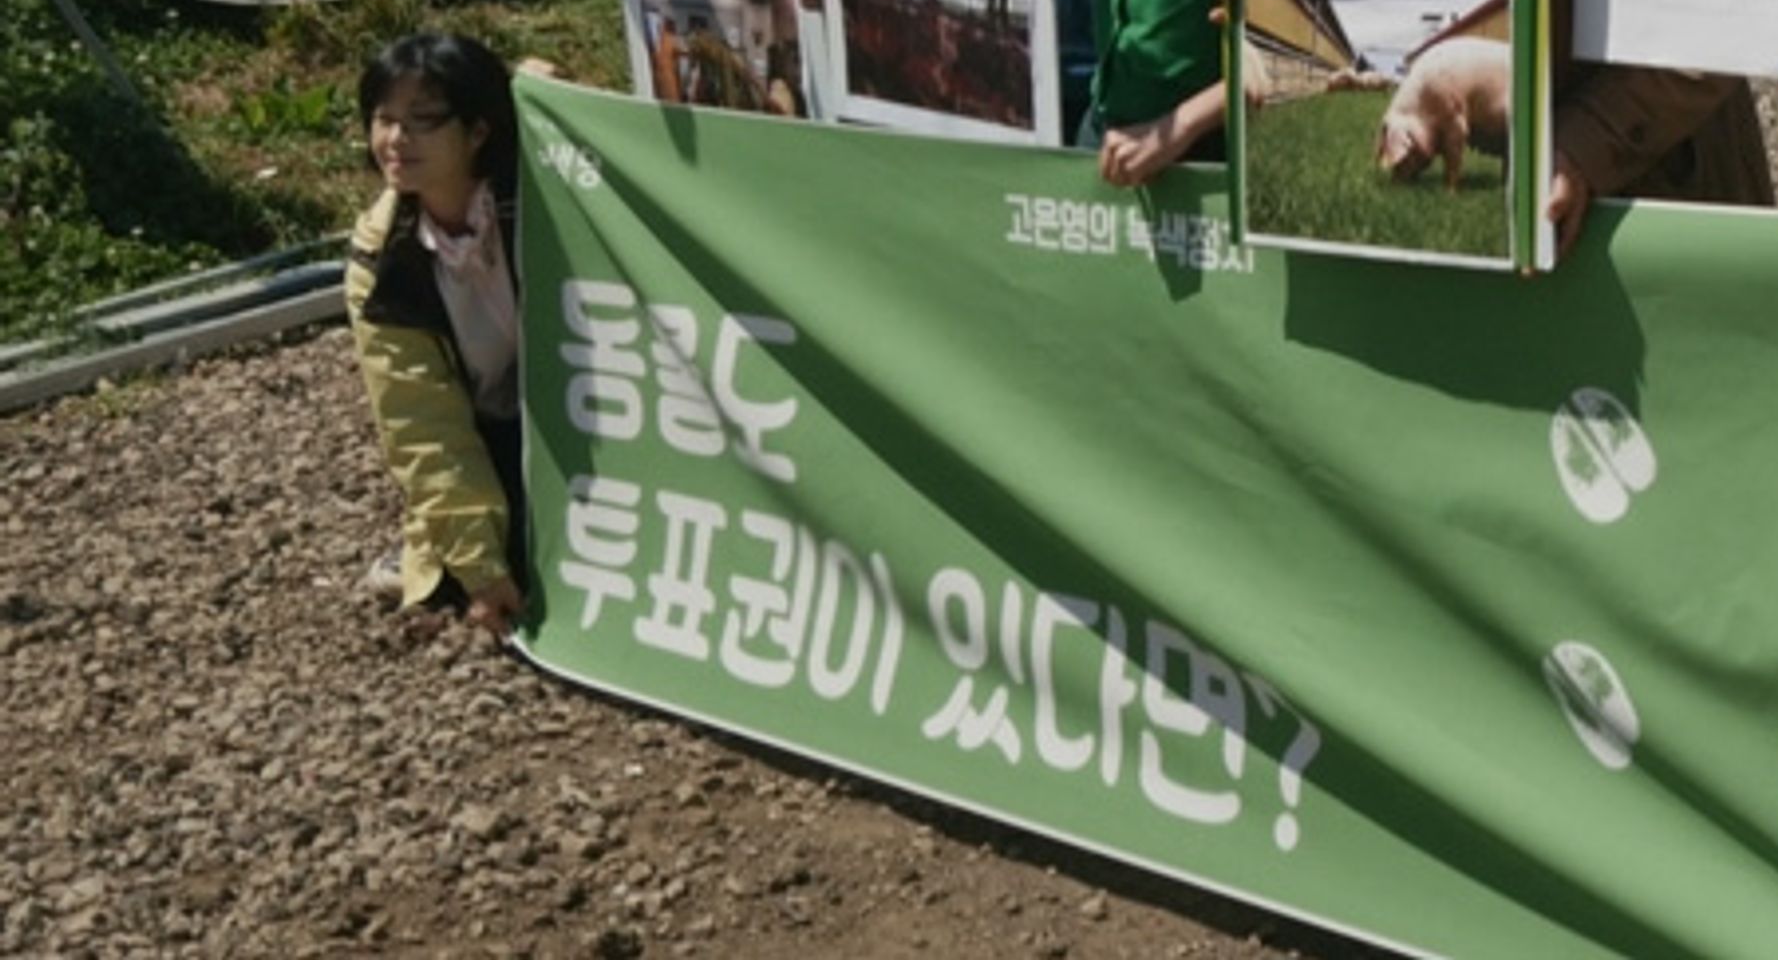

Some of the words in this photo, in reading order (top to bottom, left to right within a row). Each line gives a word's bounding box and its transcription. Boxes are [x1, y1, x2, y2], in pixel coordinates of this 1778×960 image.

[1004, 193, 1117, 255] 고은영의
[559, 279, 798, 483] 동물도
[559, 473, 903, 716] 투표권이
[922, 565, 1322, 852] 있다면?
